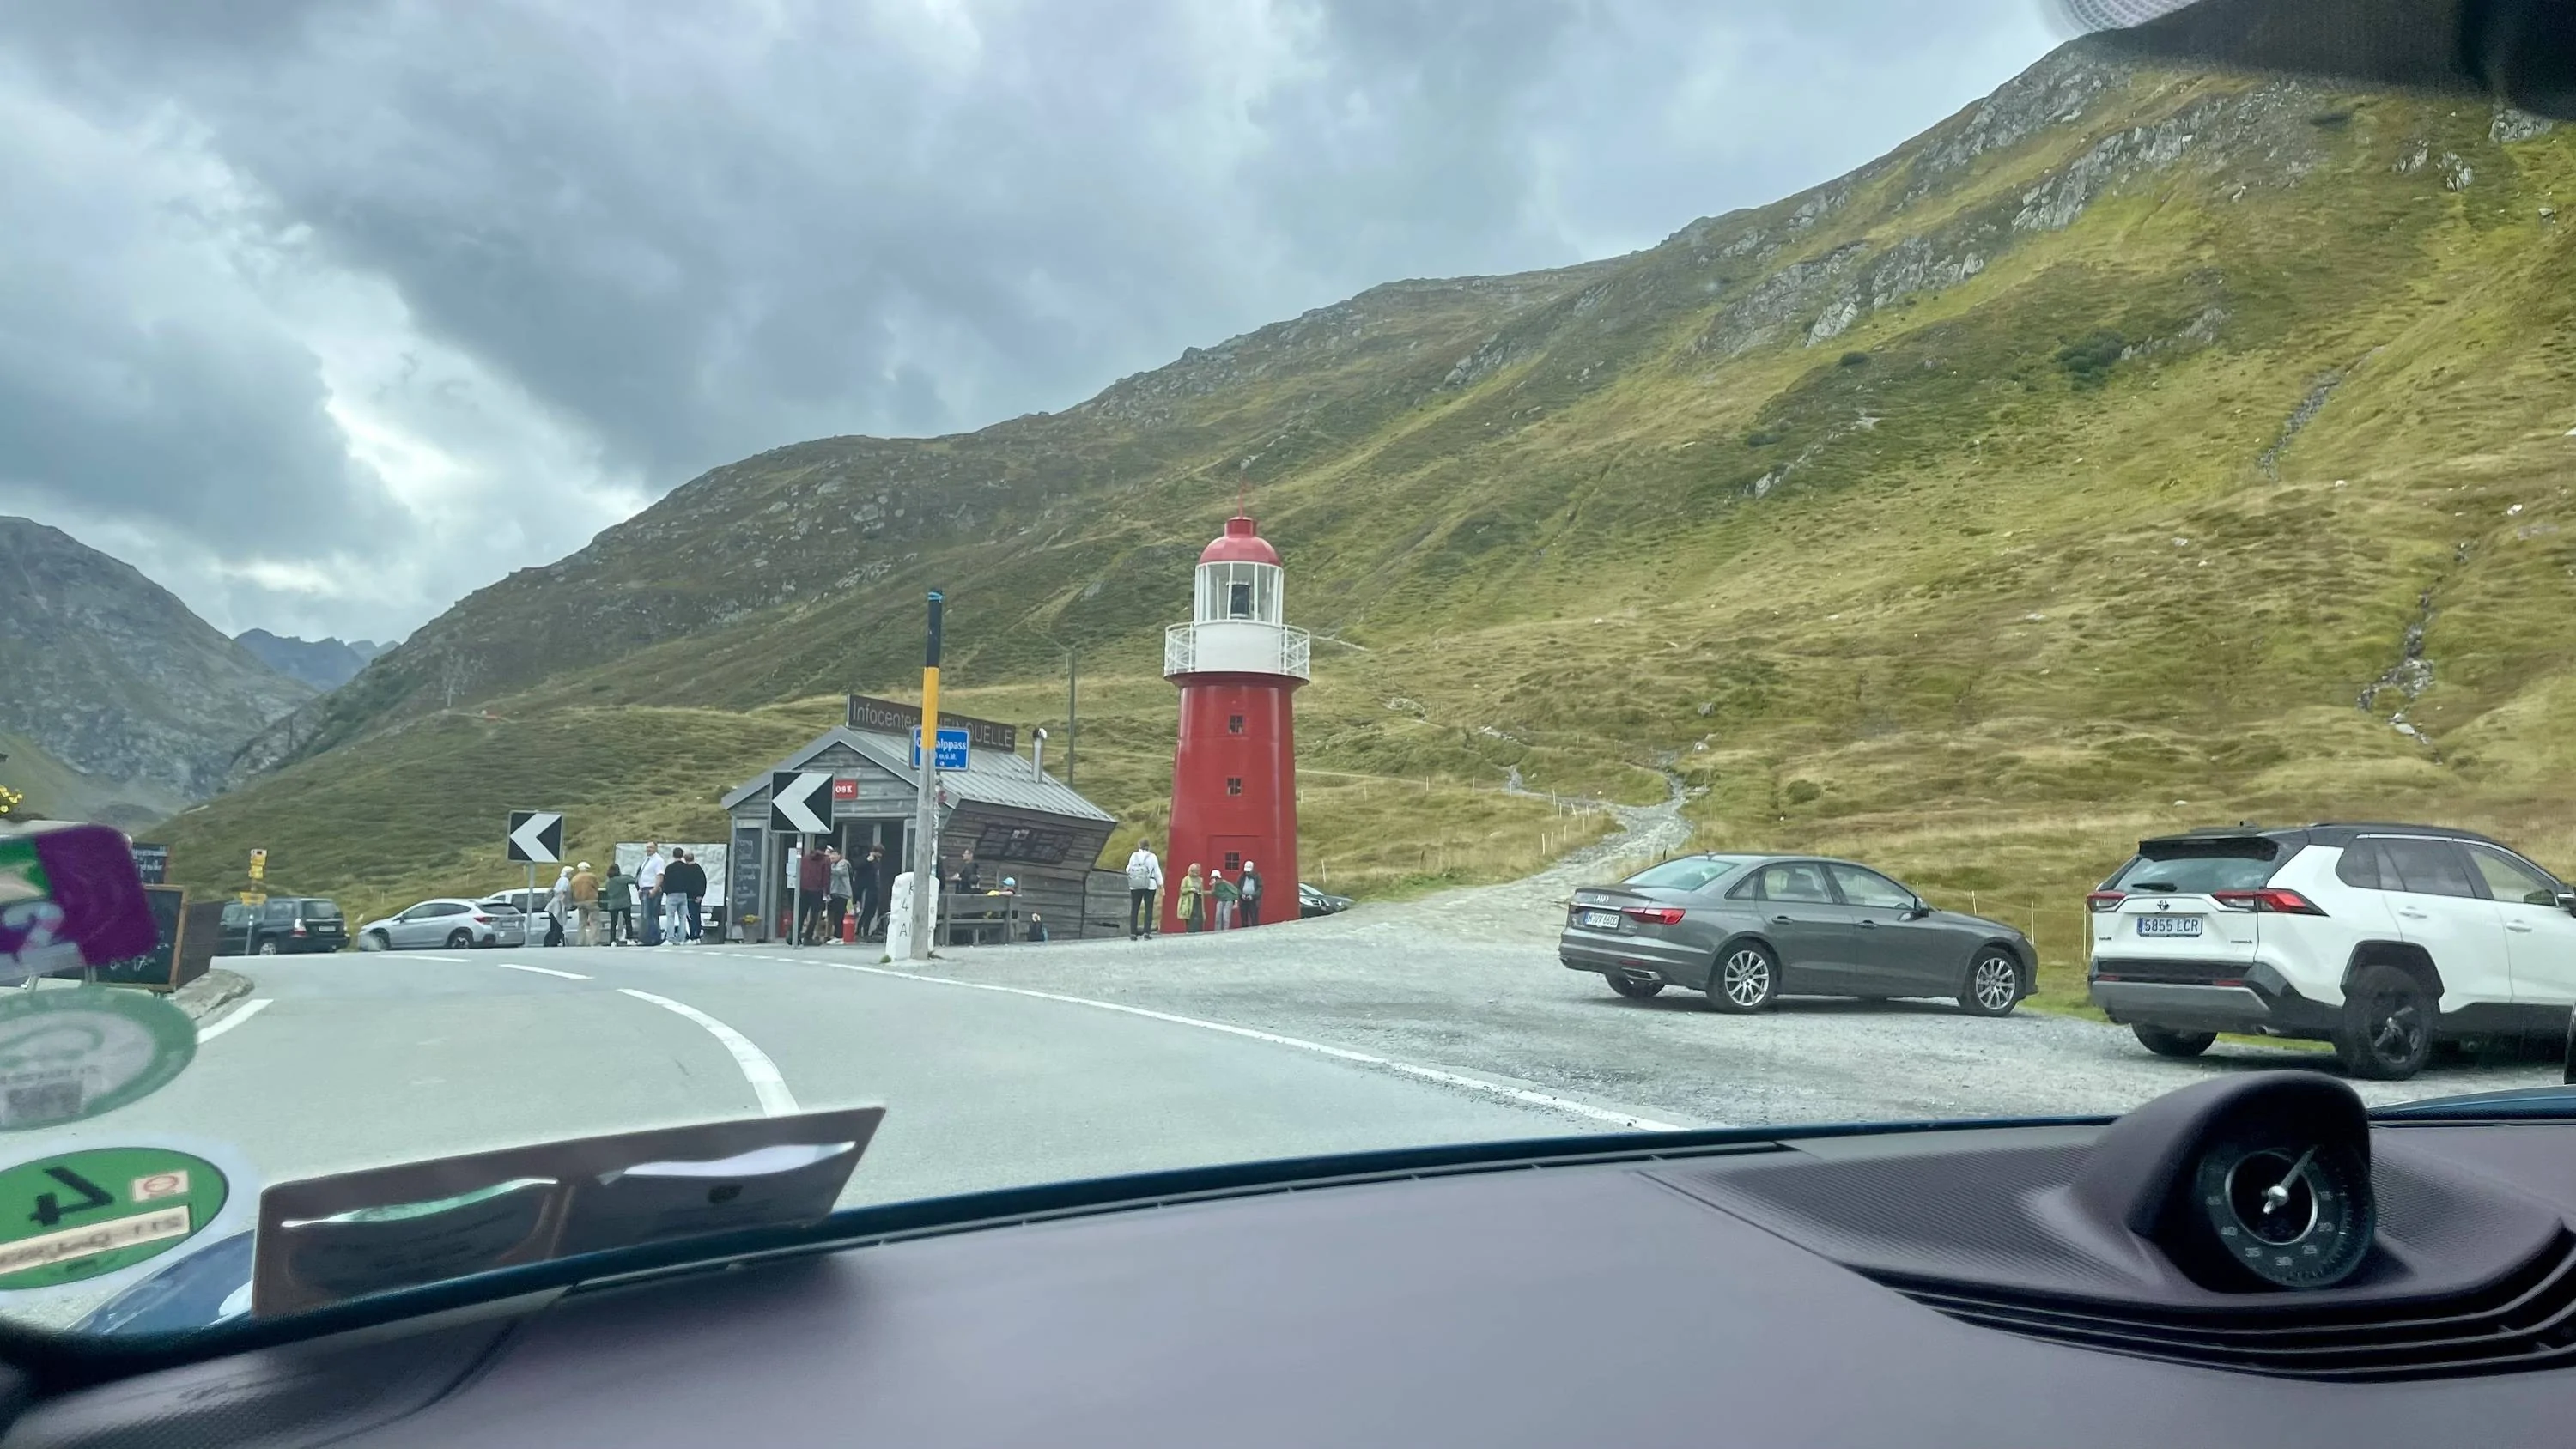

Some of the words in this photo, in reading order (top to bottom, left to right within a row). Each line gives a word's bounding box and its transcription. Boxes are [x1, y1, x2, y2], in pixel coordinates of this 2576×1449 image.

[852, 700, 917, 730] Infocenter
[939, 718, 1012, 749] EINQUELLE
[916, 737, 967, 753] Oalppass
[835, 785, 853, 793] OSK
[899, 923, 912, 937] A
[2145, 919, 2172, 932] 5855
[2177, 919, 2198, 932] LCR
[2245, 1247, 2263, 1258] 35
[2275, 1256, 2293, 1266] 30
